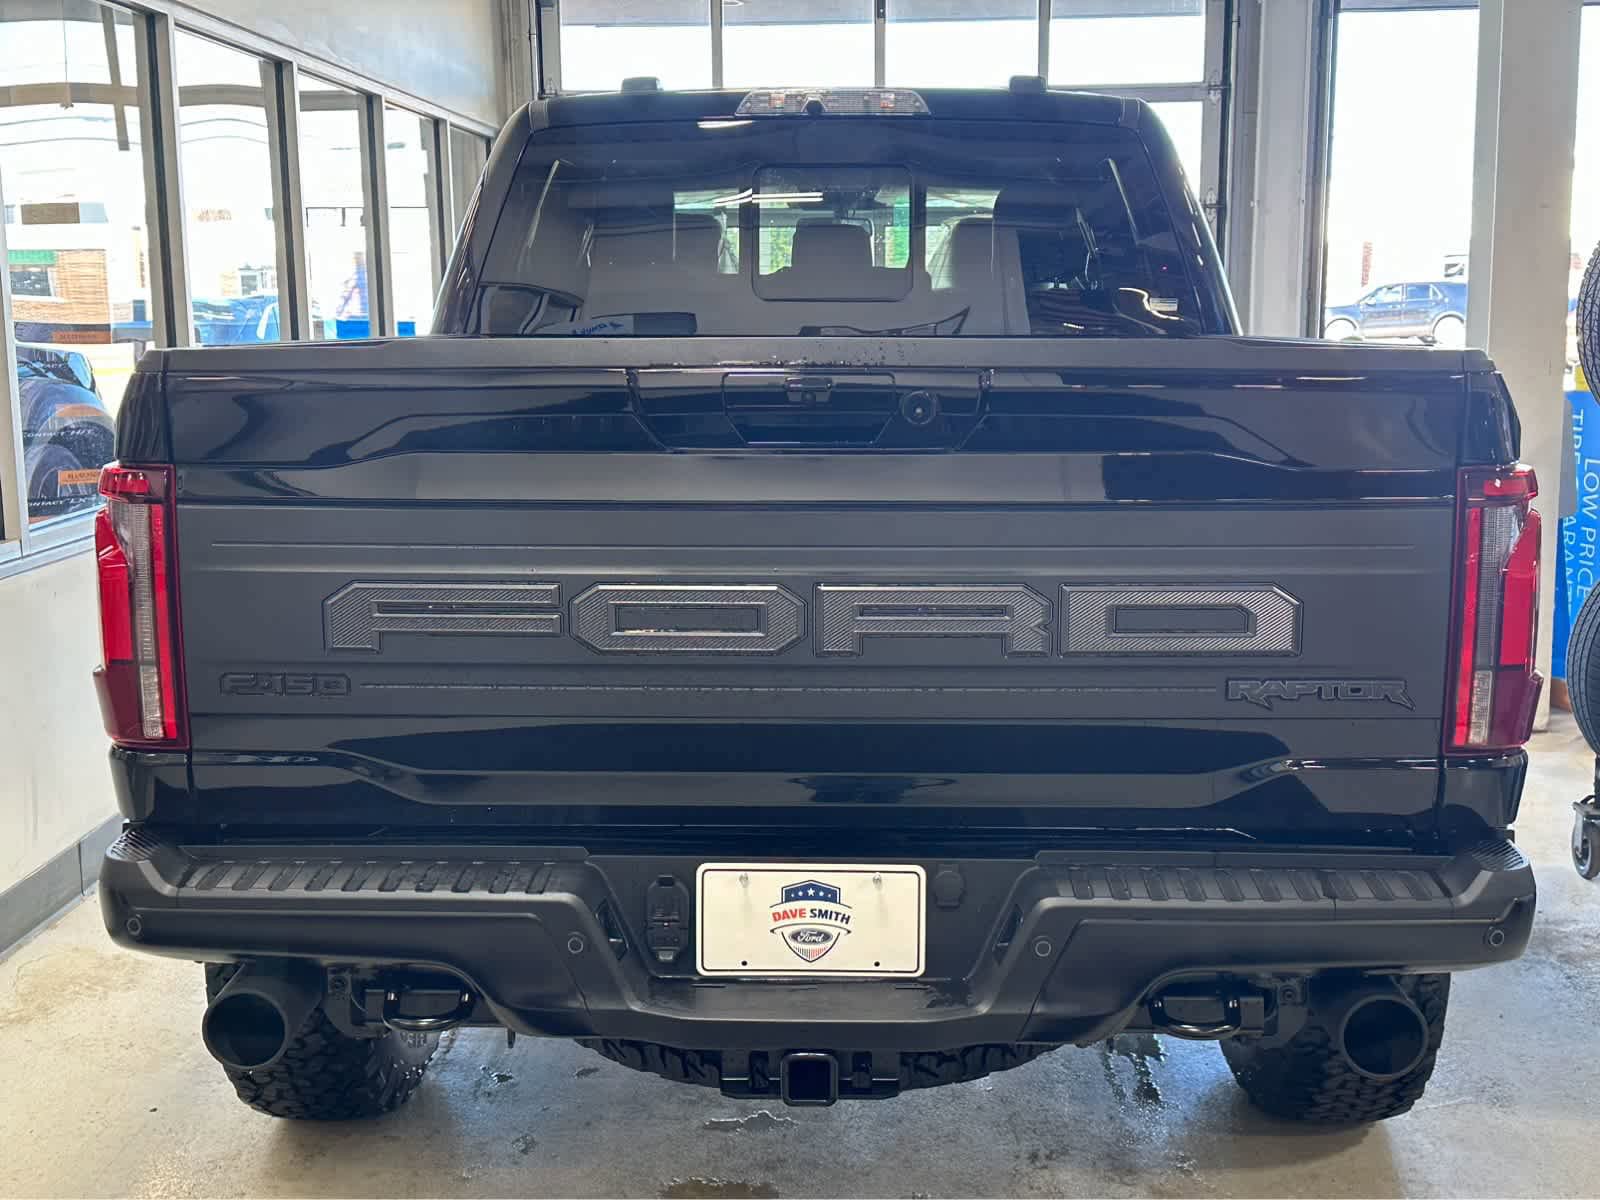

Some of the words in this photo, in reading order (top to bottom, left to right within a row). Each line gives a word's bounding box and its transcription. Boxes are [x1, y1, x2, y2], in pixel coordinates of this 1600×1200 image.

[1582, 458, 1600, 520] LOW
[1576, 526, 1596, 599] PRICE
[322, 579, 1303, 656] FORD
[1226, 678, 1416, 711] RAPTOR
[771, 907, 807, 923] DAVE
[809, 907, 852, 925] SMITH
[797, 930, 824, 943] Ford
